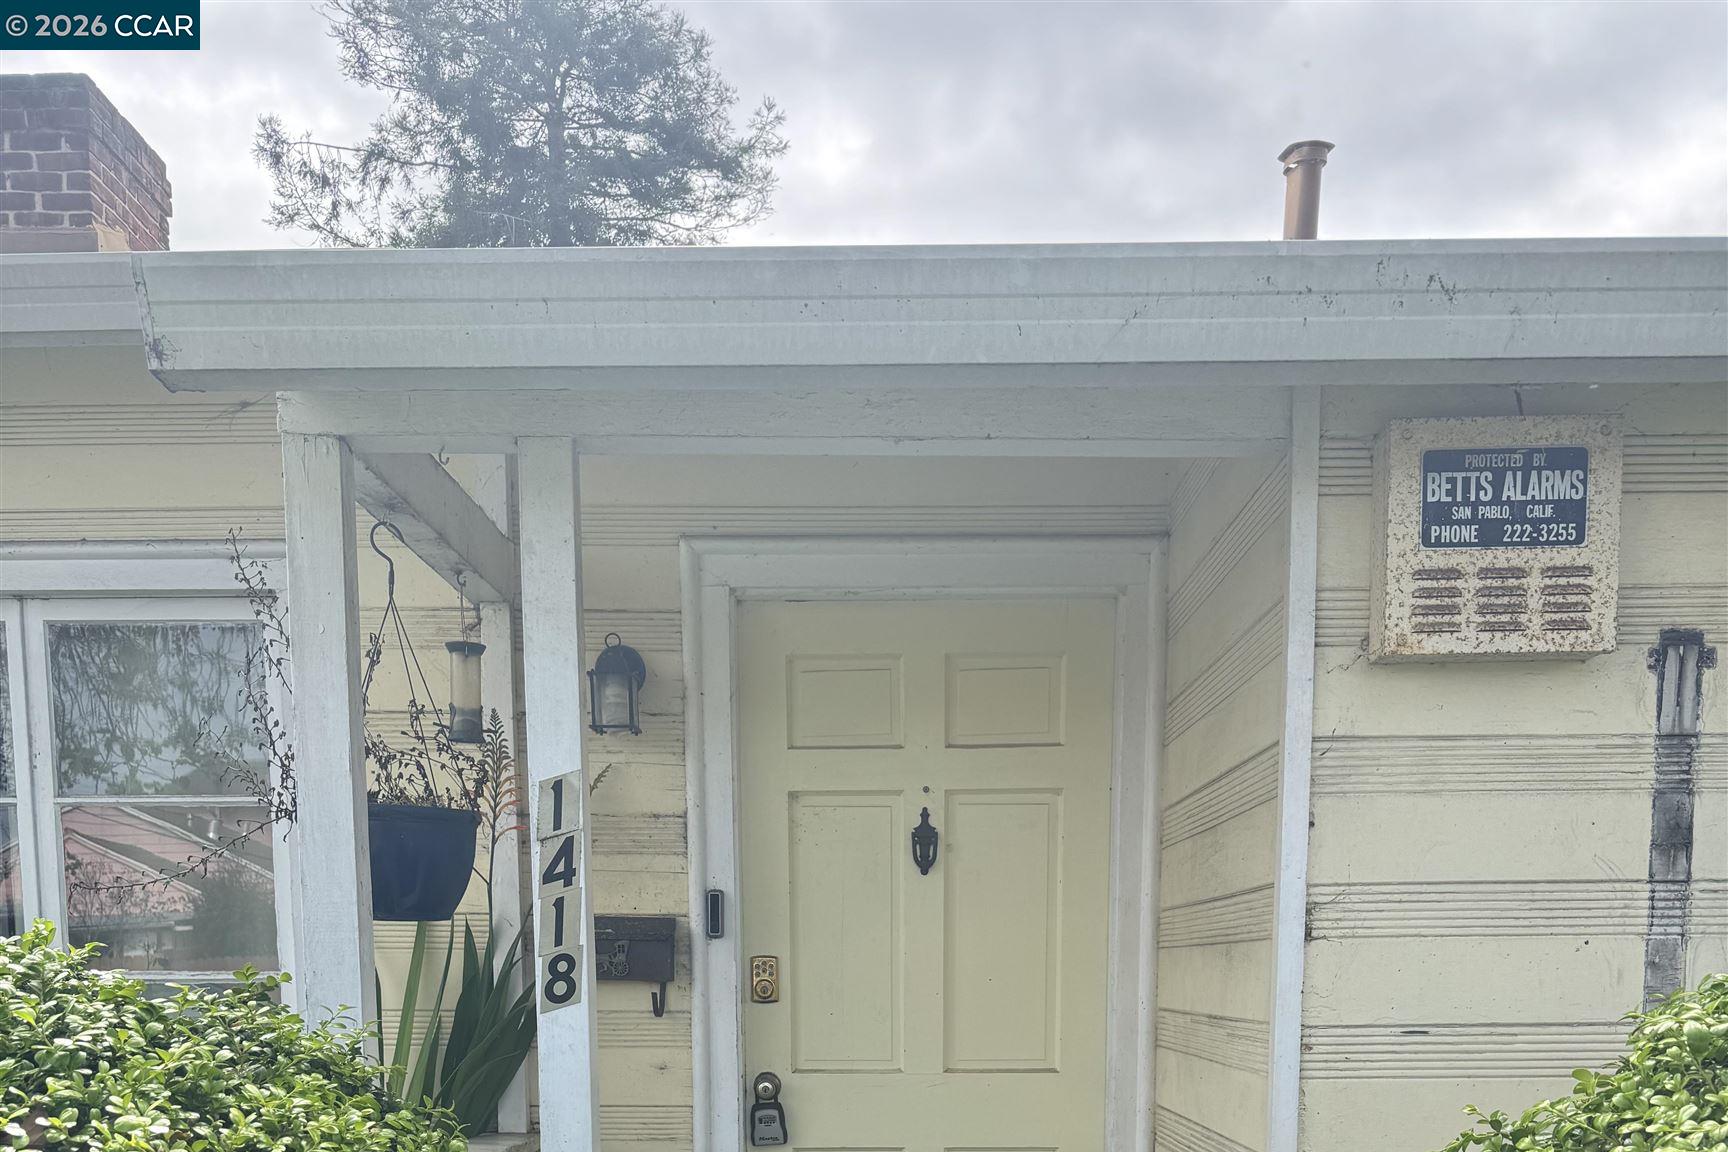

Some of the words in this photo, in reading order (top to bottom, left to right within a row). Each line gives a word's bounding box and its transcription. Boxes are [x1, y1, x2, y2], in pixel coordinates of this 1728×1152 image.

[1465, 453, 1523, 468] PROTECTED
[1426, 470, 1493, 502] BETTS
[1501, 469, 1584, 501] ALARMS
[1451, 506, 1472, 520] SAN
[1478, 505, 1512, 521] PABLO,
[1526, 504, 1556, 518] CALIF.
[1430, 525, 1479, 543] PHONE
[1502, 523, 1577, 542] 222-3255
[542, 778, 577, 1005] 1418
